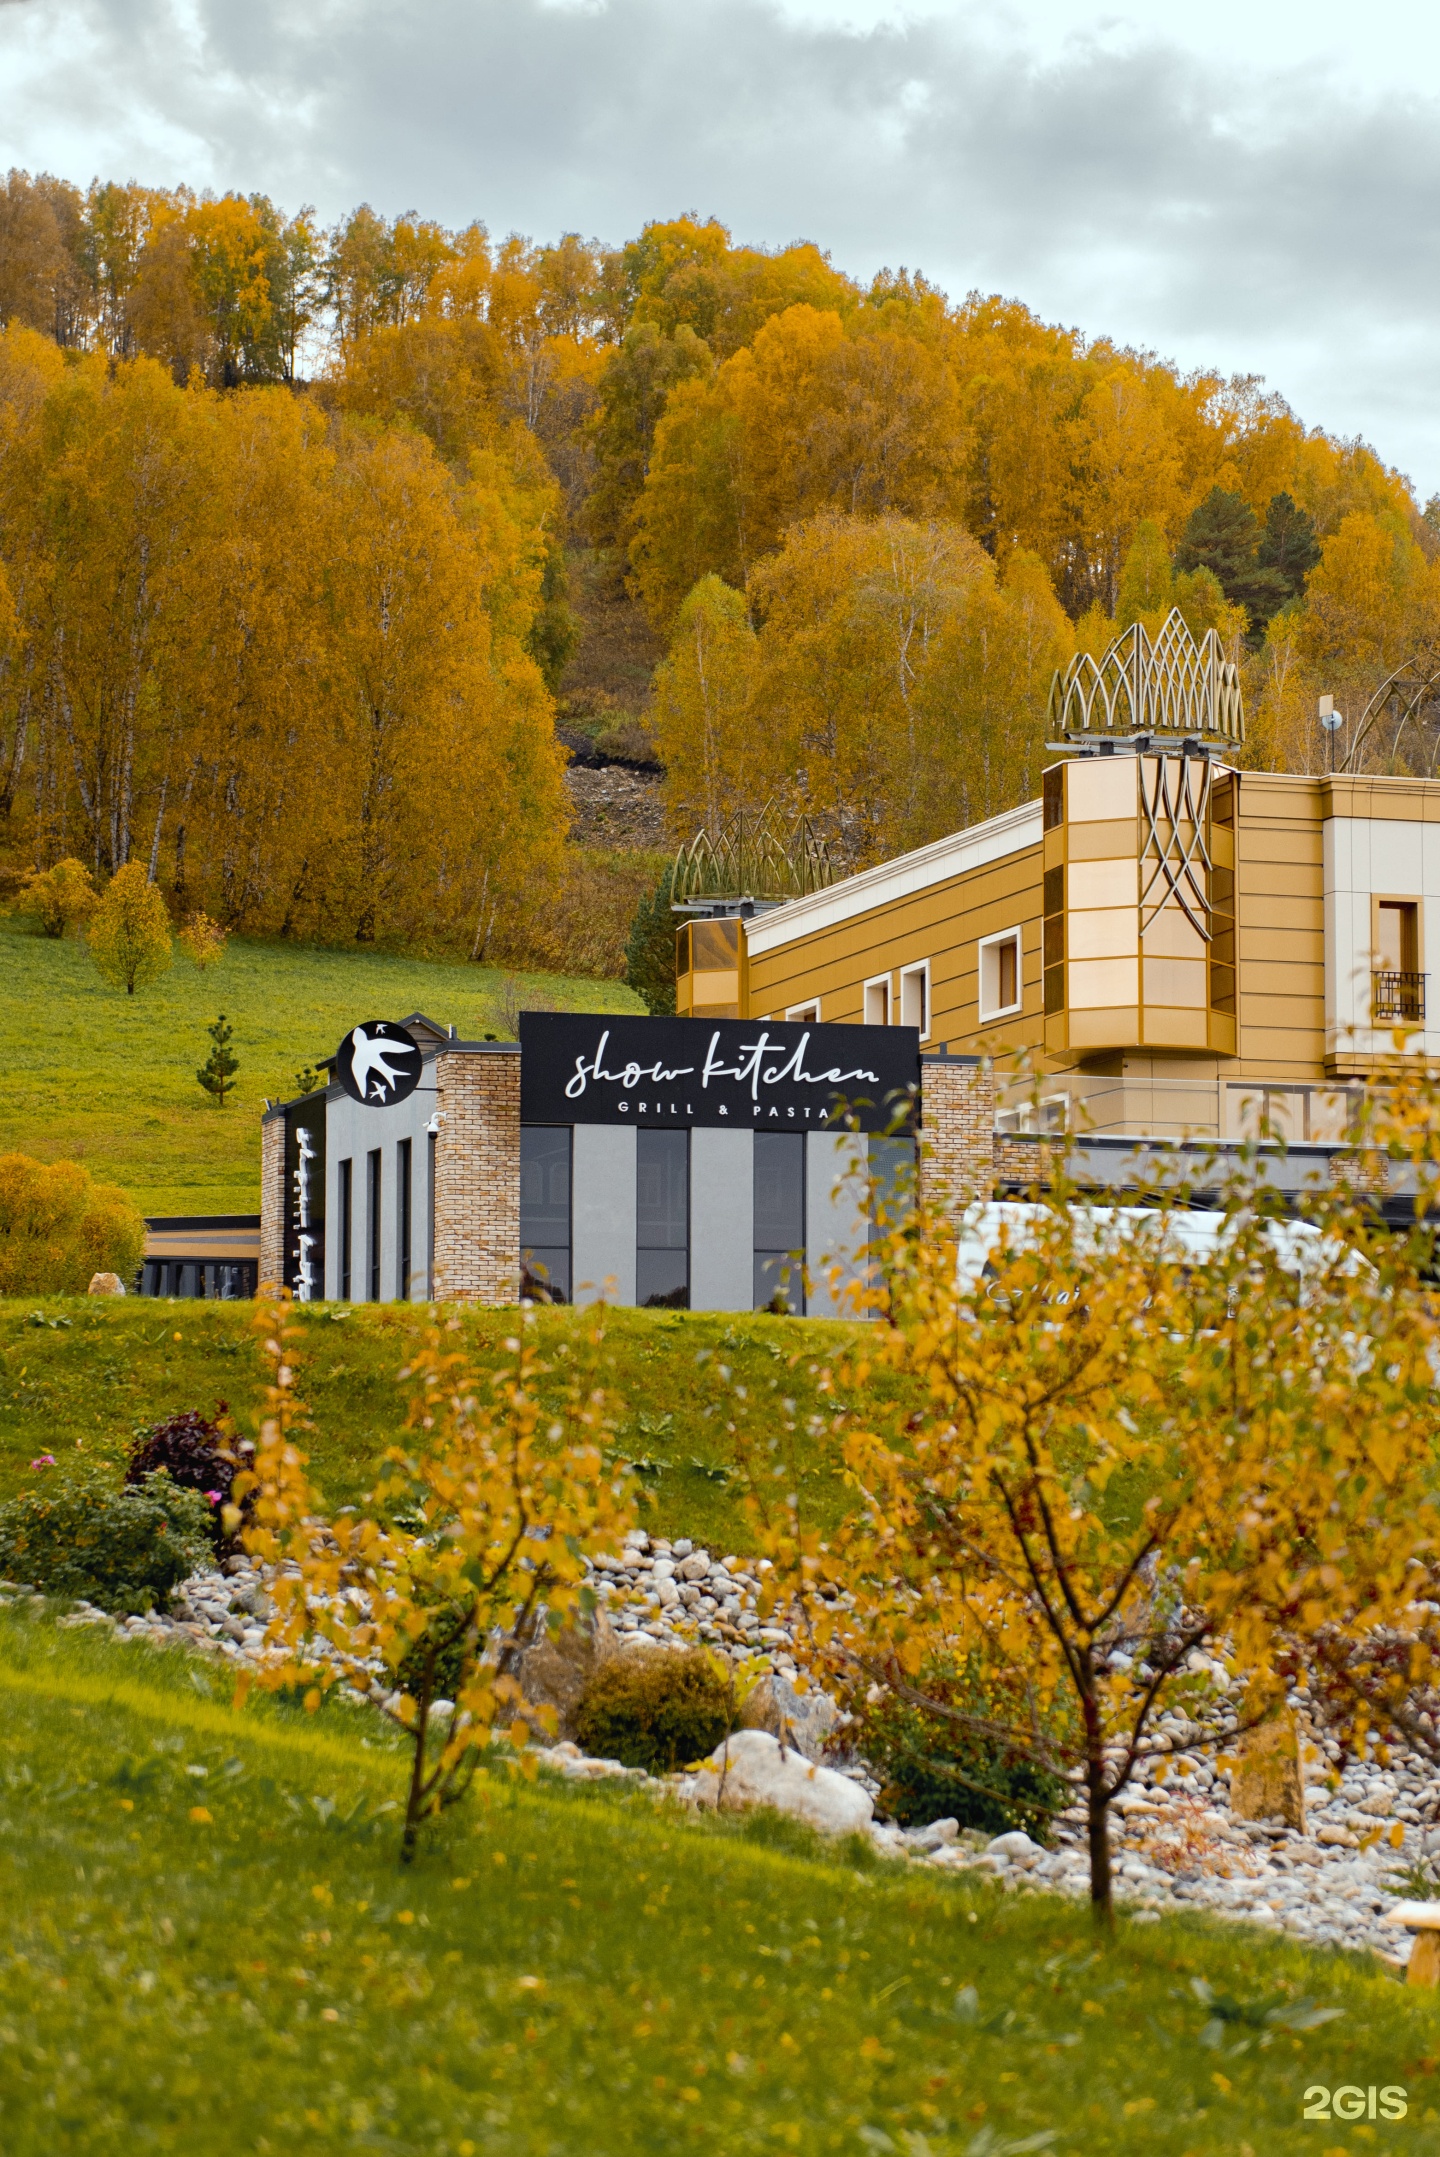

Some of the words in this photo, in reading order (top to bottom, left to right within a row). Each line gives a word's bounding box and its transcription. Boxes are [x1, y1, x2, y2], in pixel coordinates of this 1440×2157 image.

[564, 1030, 694, 1099] show
[701, 1031, 880, 1100] kitchen
[617, 1101, 694, 1115] GRILL
[718, 1104, 729, 1116] &
[753, 1105, 829, 1119] PASTA
